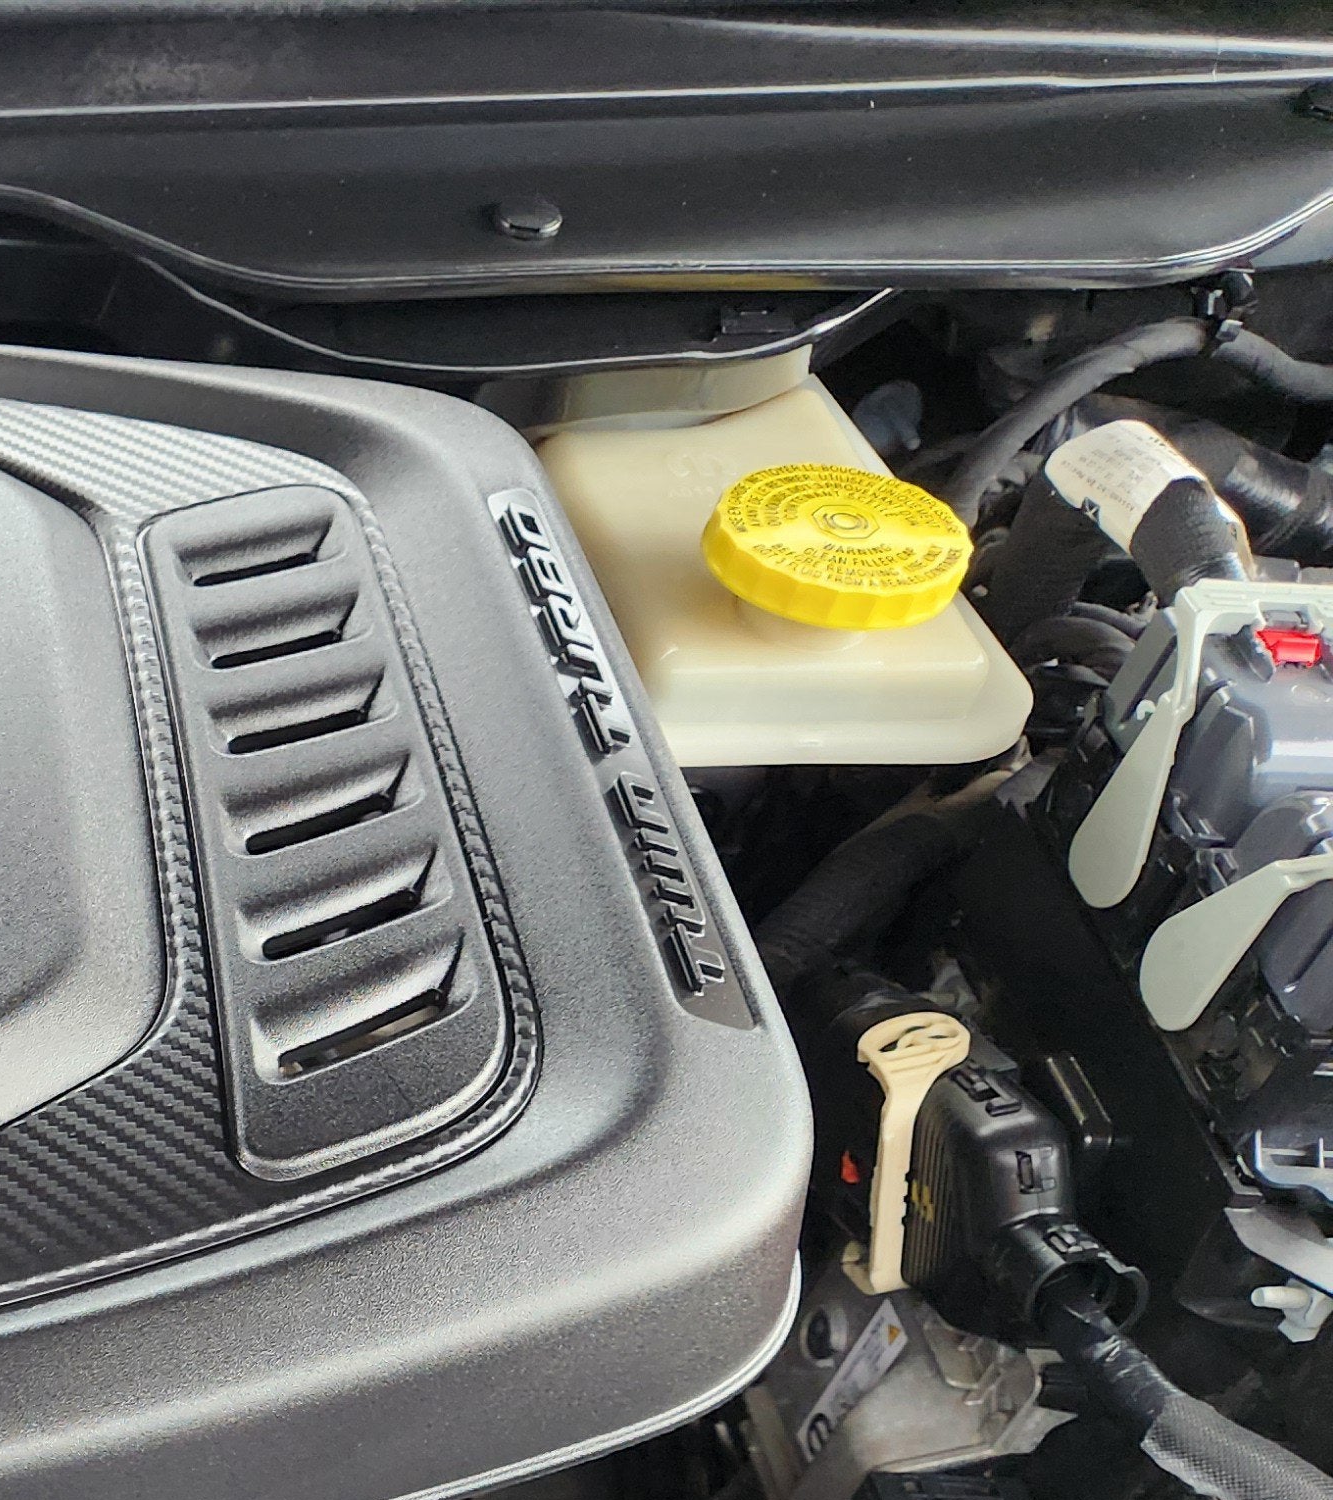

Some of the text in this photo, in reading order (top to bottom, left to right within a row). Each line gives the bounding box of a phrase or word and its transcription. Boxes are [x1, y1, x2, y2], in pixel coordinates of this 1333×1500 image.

[821, 464, 885, 481] BOUCHON
[804, 547, 848, 565] CLEAN
[853, 556, 898, 568] FILLER
[819, 543, 892, 555] WARNING
[499, 500, 726, 997] TWIN TURBO
